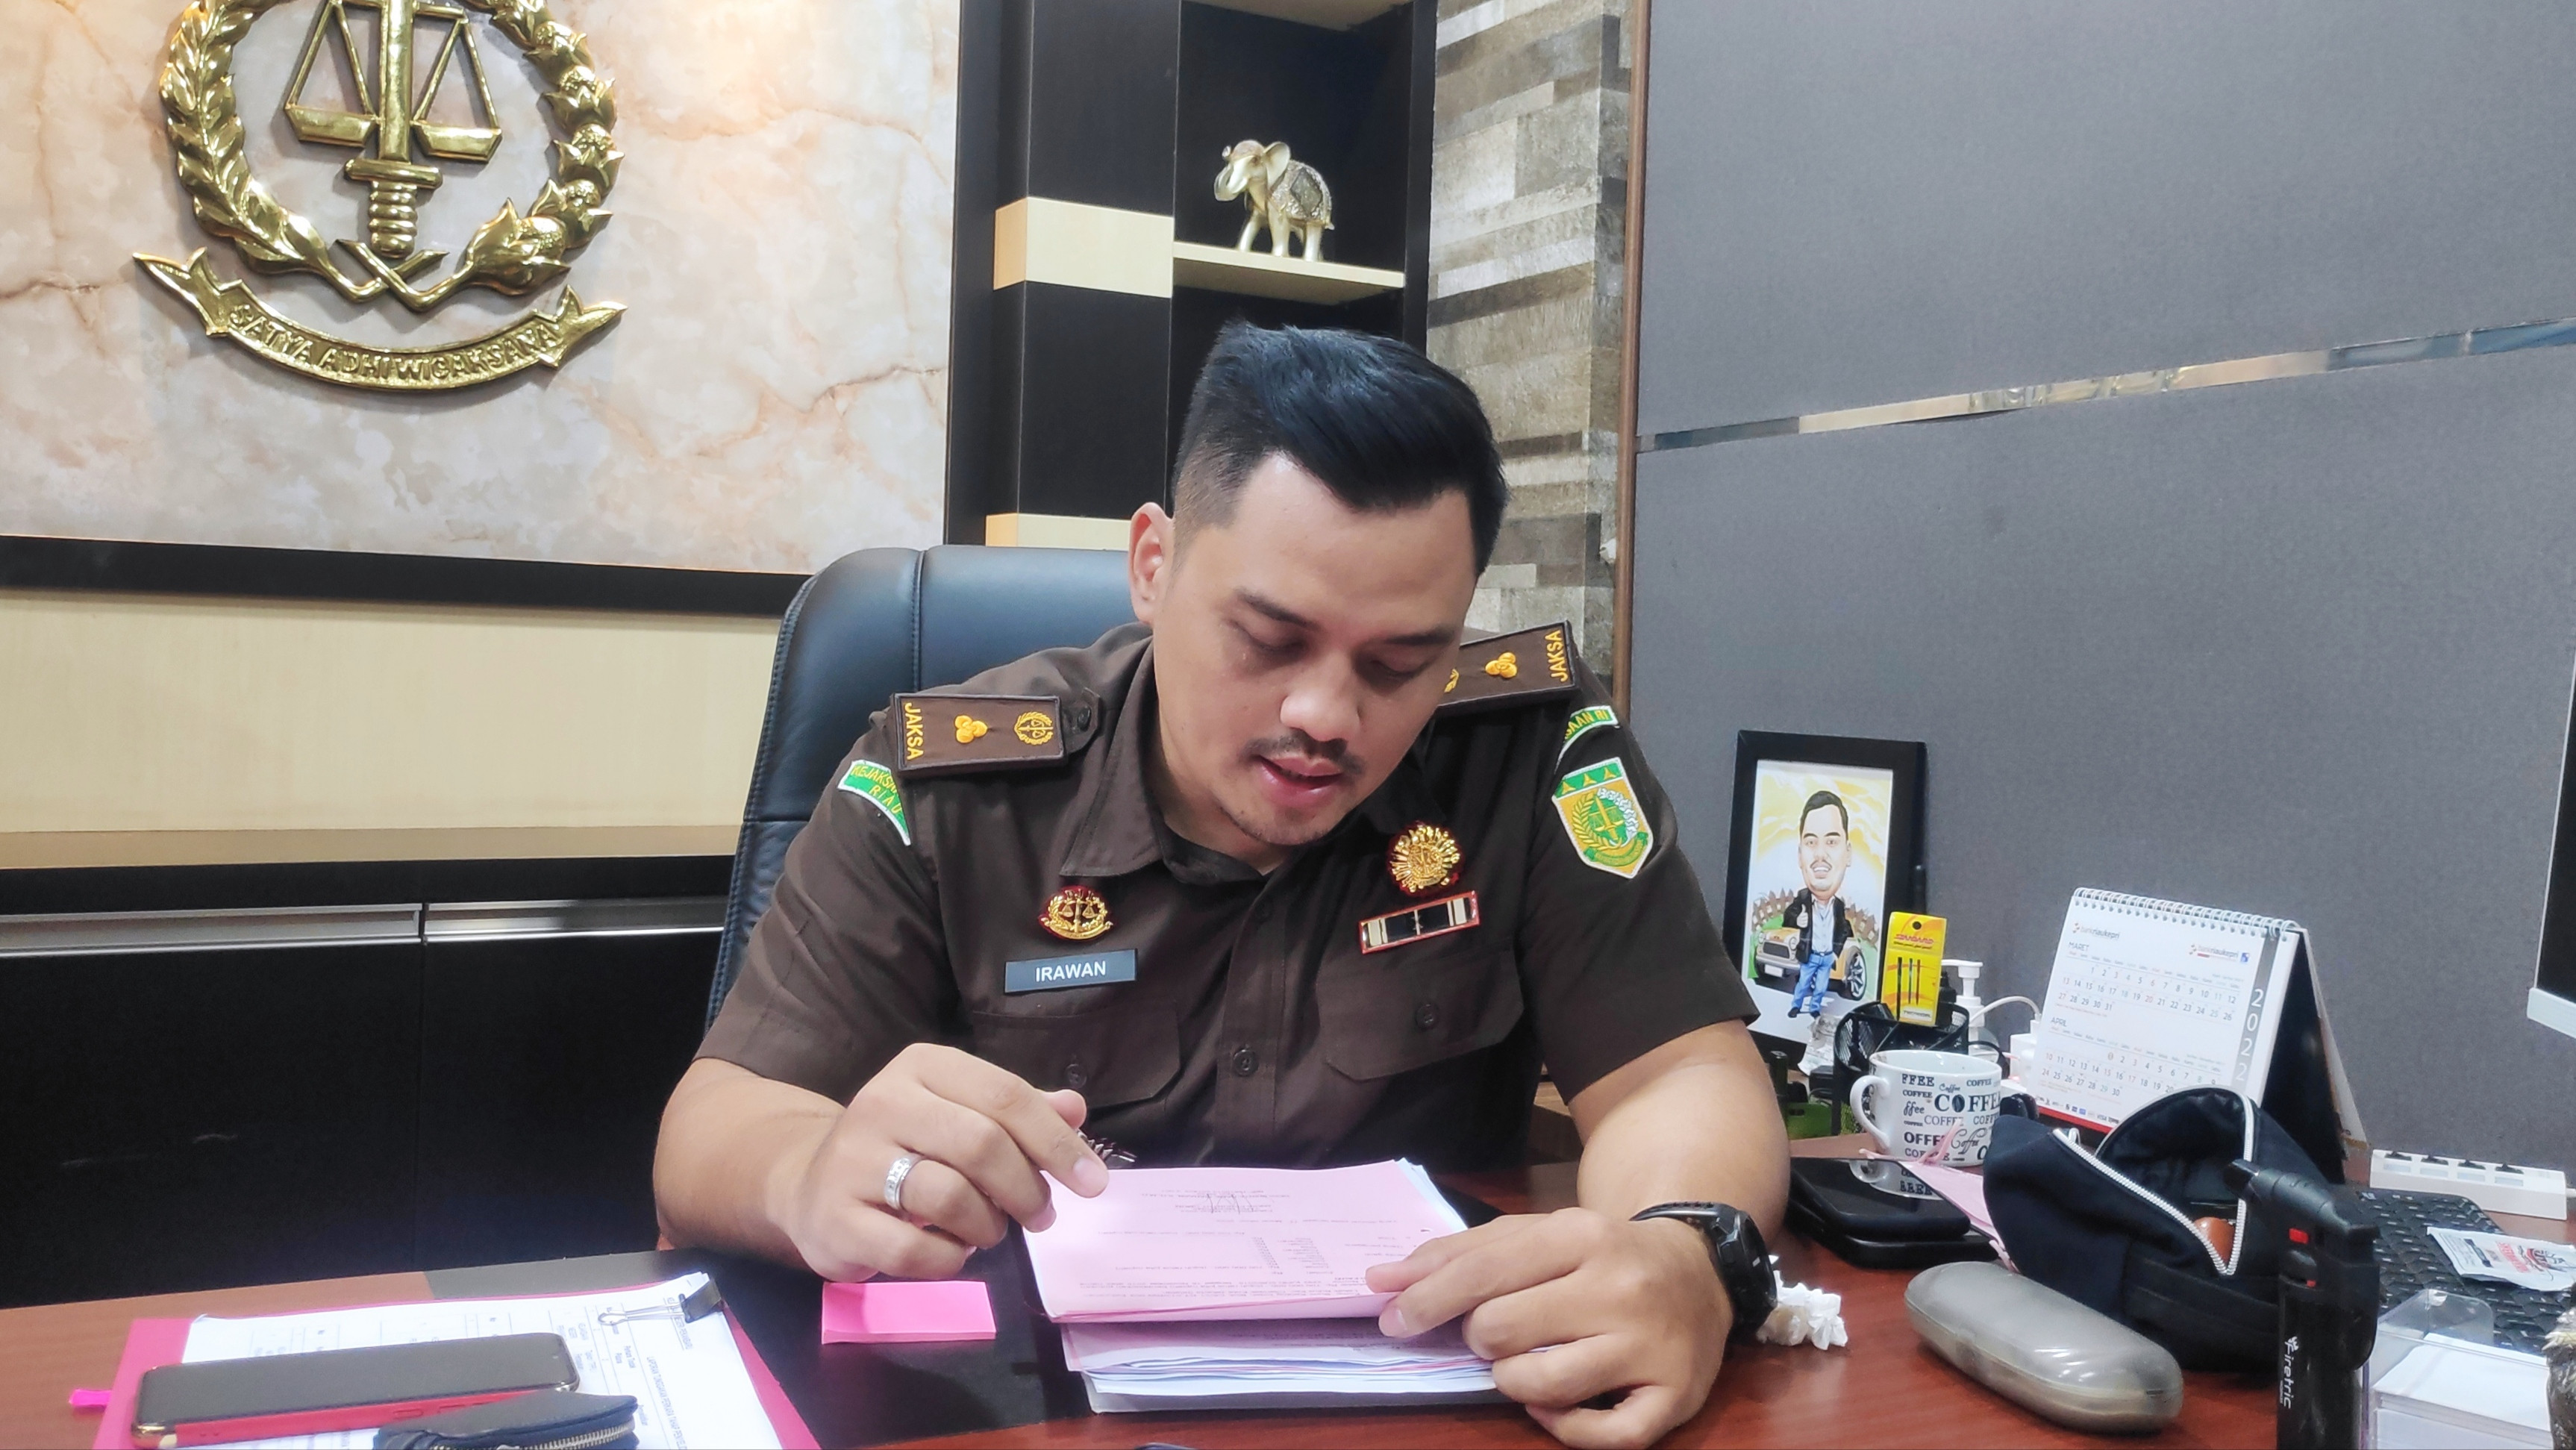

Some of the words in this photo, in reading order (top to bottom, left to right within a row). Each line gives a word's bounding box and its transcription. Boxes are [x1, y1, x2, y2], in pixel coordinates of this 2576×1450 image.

[229, 304, 313, 363] SATYA
[1545, 630, 1568, 681] JAKSA
[904, 702, 924, 760] JAKSA
[869, 784, 902, 813] RIAU
[1036, 960, 1106, 982] IRAWAN
[1902, 1073, 1934, 1087] FFEE
[1904, 1101, 1925, 1116] ffee
[2284, 1341, 2295, 1409] Firetric
